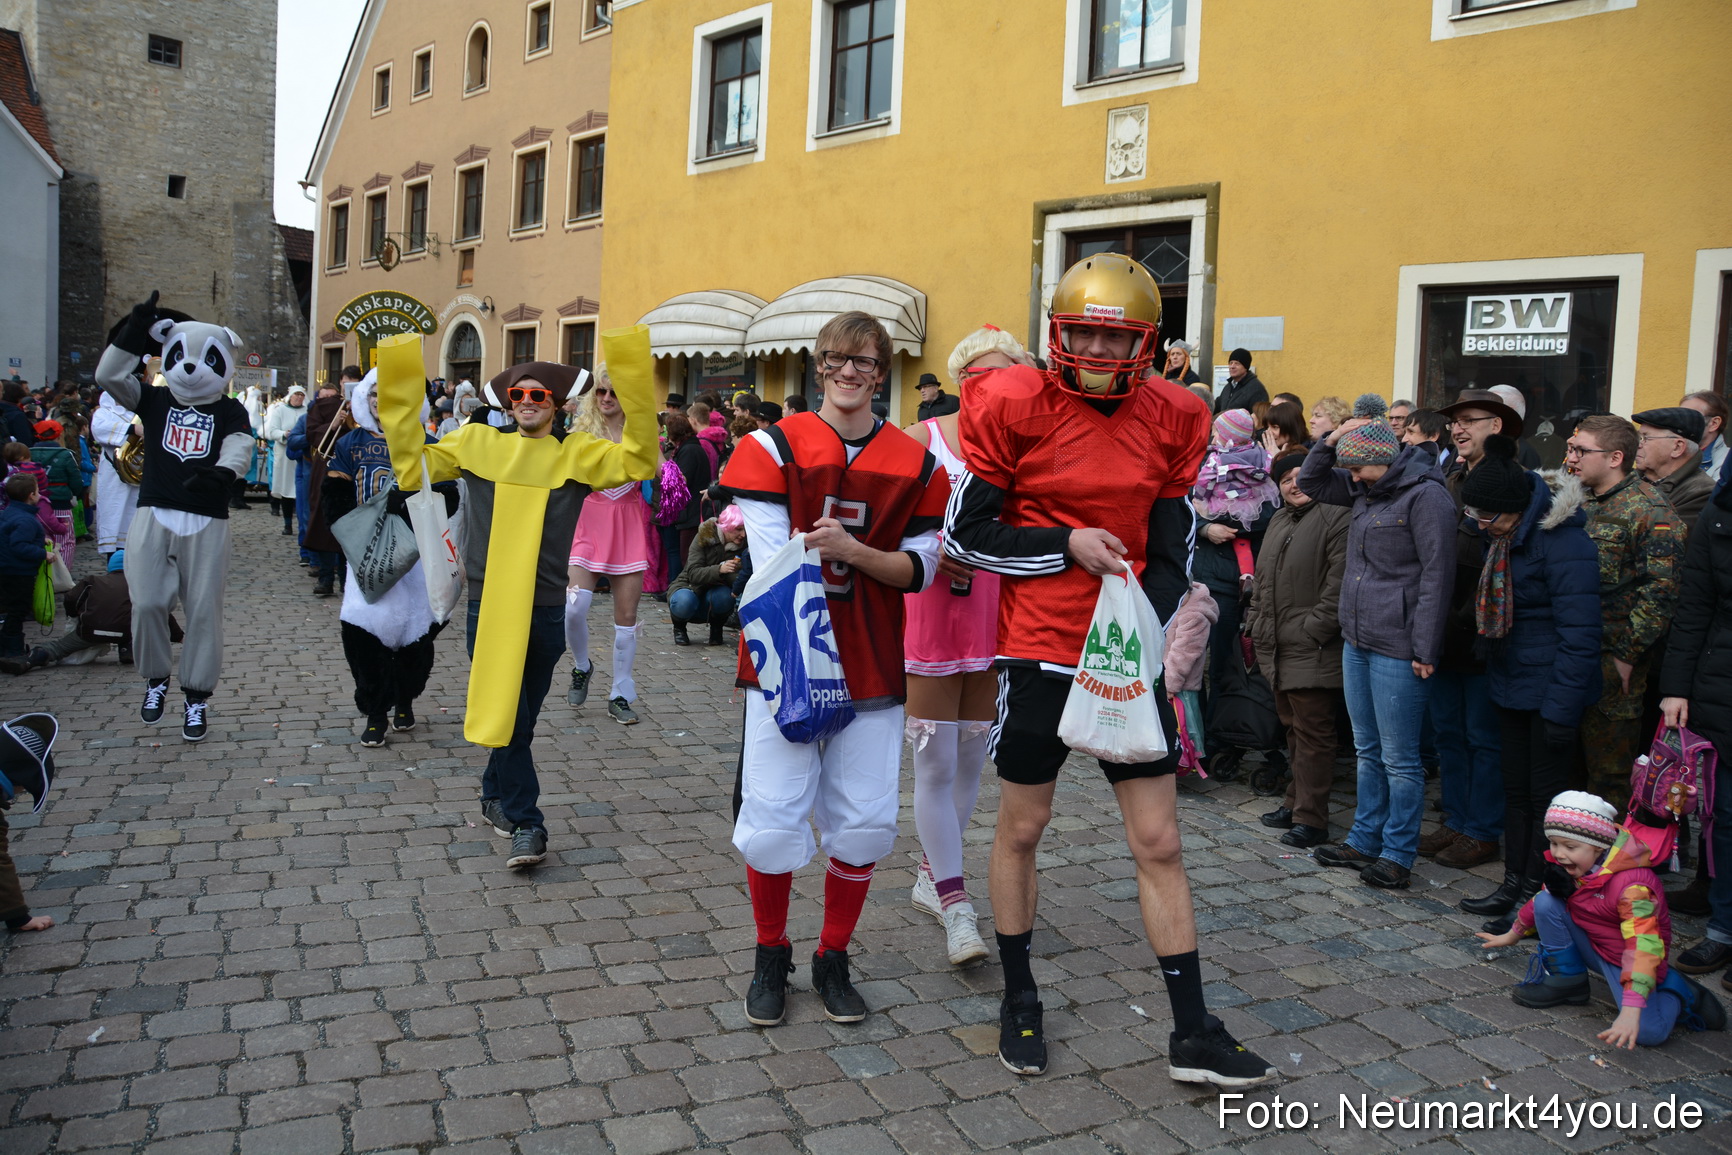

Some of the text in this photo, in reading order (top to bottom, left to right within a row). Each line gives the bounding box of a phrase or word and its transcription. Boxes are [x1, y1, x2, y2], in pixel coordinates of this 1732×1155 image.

[337, 295, 432, 330] Blaskapelle
[1092, 307, 1116, 316] Riddell
[1470, 297, 1566, 330] BW
[356, 315, 417, 336] Pilsach
[1464, 335, 1568, 354] Bekleidung
[168, 424, 205, 453] NFL
